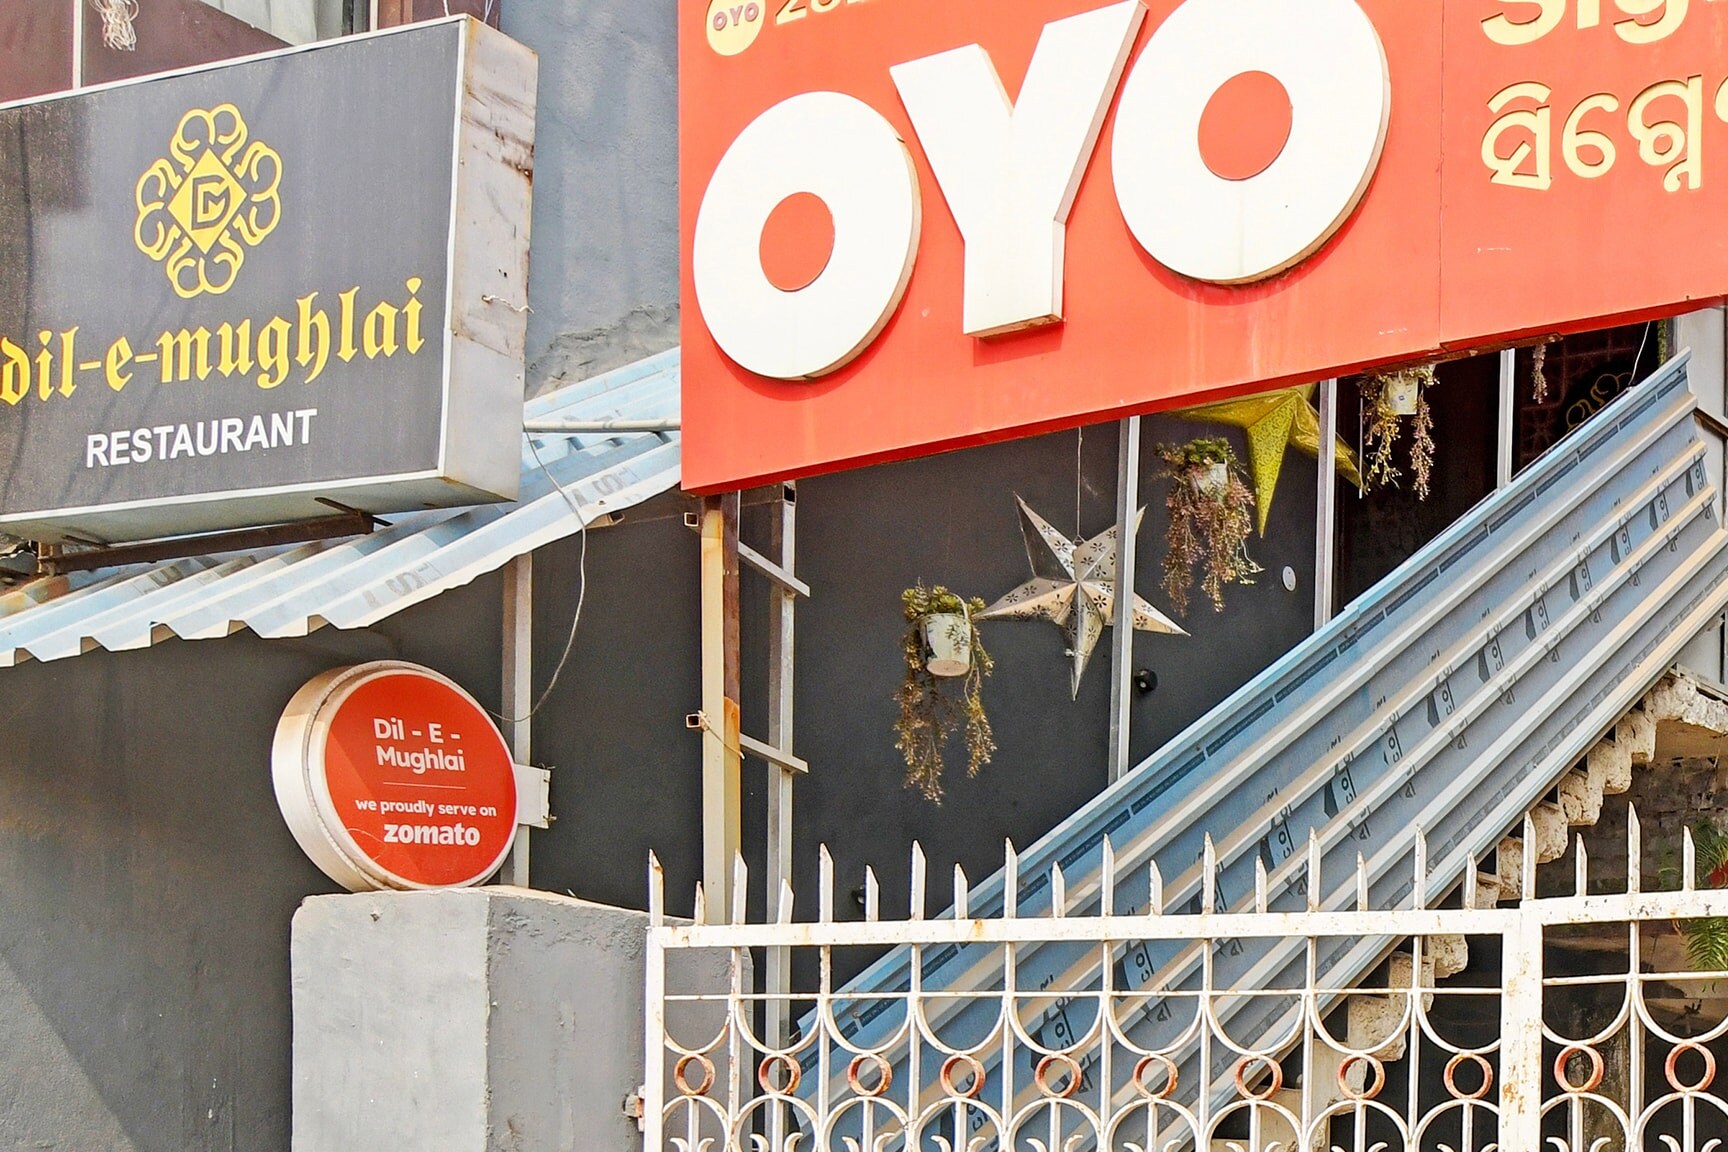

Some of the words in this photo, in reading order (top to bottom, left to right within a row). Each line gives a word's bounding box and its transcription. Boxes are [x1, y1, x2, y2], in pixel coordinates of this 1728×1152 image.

[713, 2, 759, 31] OYO
[693, 0, 1391, 381] OYO
[86, 408, 317, 468] RESTAURANT
[373, 717, 404, 741] Dil
[428, 723, 444, 744] E
[376, 745, 465, 775] Mughlai
[355, 800, 377, 812] we
[380, 800, 435, 817] proudly
[438, 804, 477, 816] serve
[479, 806, 497, 817] on
[383, 822, 480, 847] zomato
